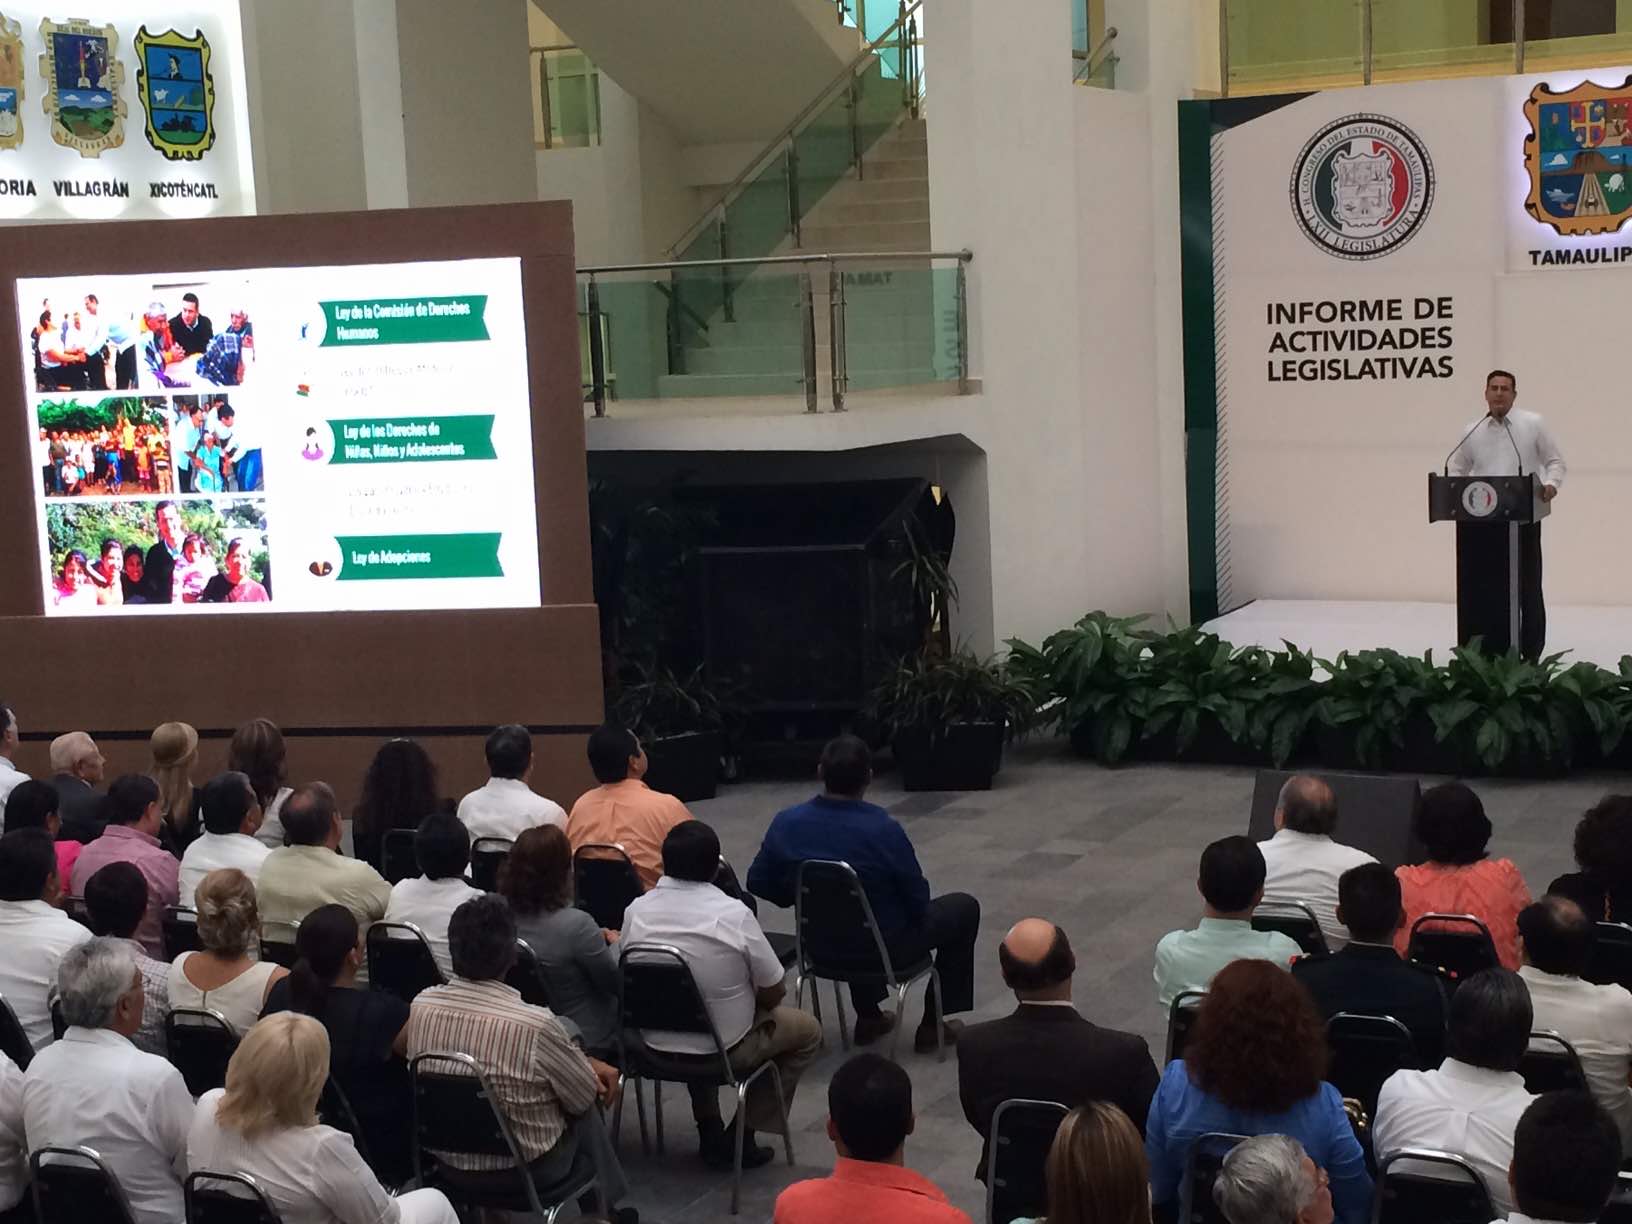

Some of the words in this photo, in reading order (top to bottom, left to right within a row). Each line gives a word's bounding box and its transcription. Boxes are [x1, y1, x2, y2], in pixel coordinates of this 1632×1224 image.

[1327, 131, 1344, 146] DEL
[1347, 126, 1386, 138] ESTADO
[1386, 131, 1400, 142] DE
[1398, 140, 1424, 199] TAMAULIPAS
[53, 178, 129, 198] VILLAGRÁN
[150, 179, 218, 199] XICOTÉNCATL
[1334, 209, 1419, 252] LEGISLATURA
[1529, 246, 1632, 265] TAMAULIP
[335, 305, 350, 321] Ley
[351, 305, 363, 319] de
[364, 304, 373, 319] la
[373, 303, 415, 318] Comisión
[416, 302, 427, 317] de
[428, 301, 470, 316] Derechos
[1267, 298, 1403, 325] INFORME
[1414, 297, 1453, 320] DE
[337, 326, 379, 340] Humanos
[1268, 326, 1453, 353] ACTIVIDADES
[1268, 355, 1454, 382] LEGISLATIVAS
[344, 424, 358, 440] Ley
[360, 424, 371, 438] de
[386, 423, 427, 438] Derechos
[428, 421, 440, 436] de
[406, 441, 465, 456] Adolescentes
[352, 551, 367, 566] Ley
[368, 550, 379, 564] de
[381, 549, 431, 566] Adopciones
